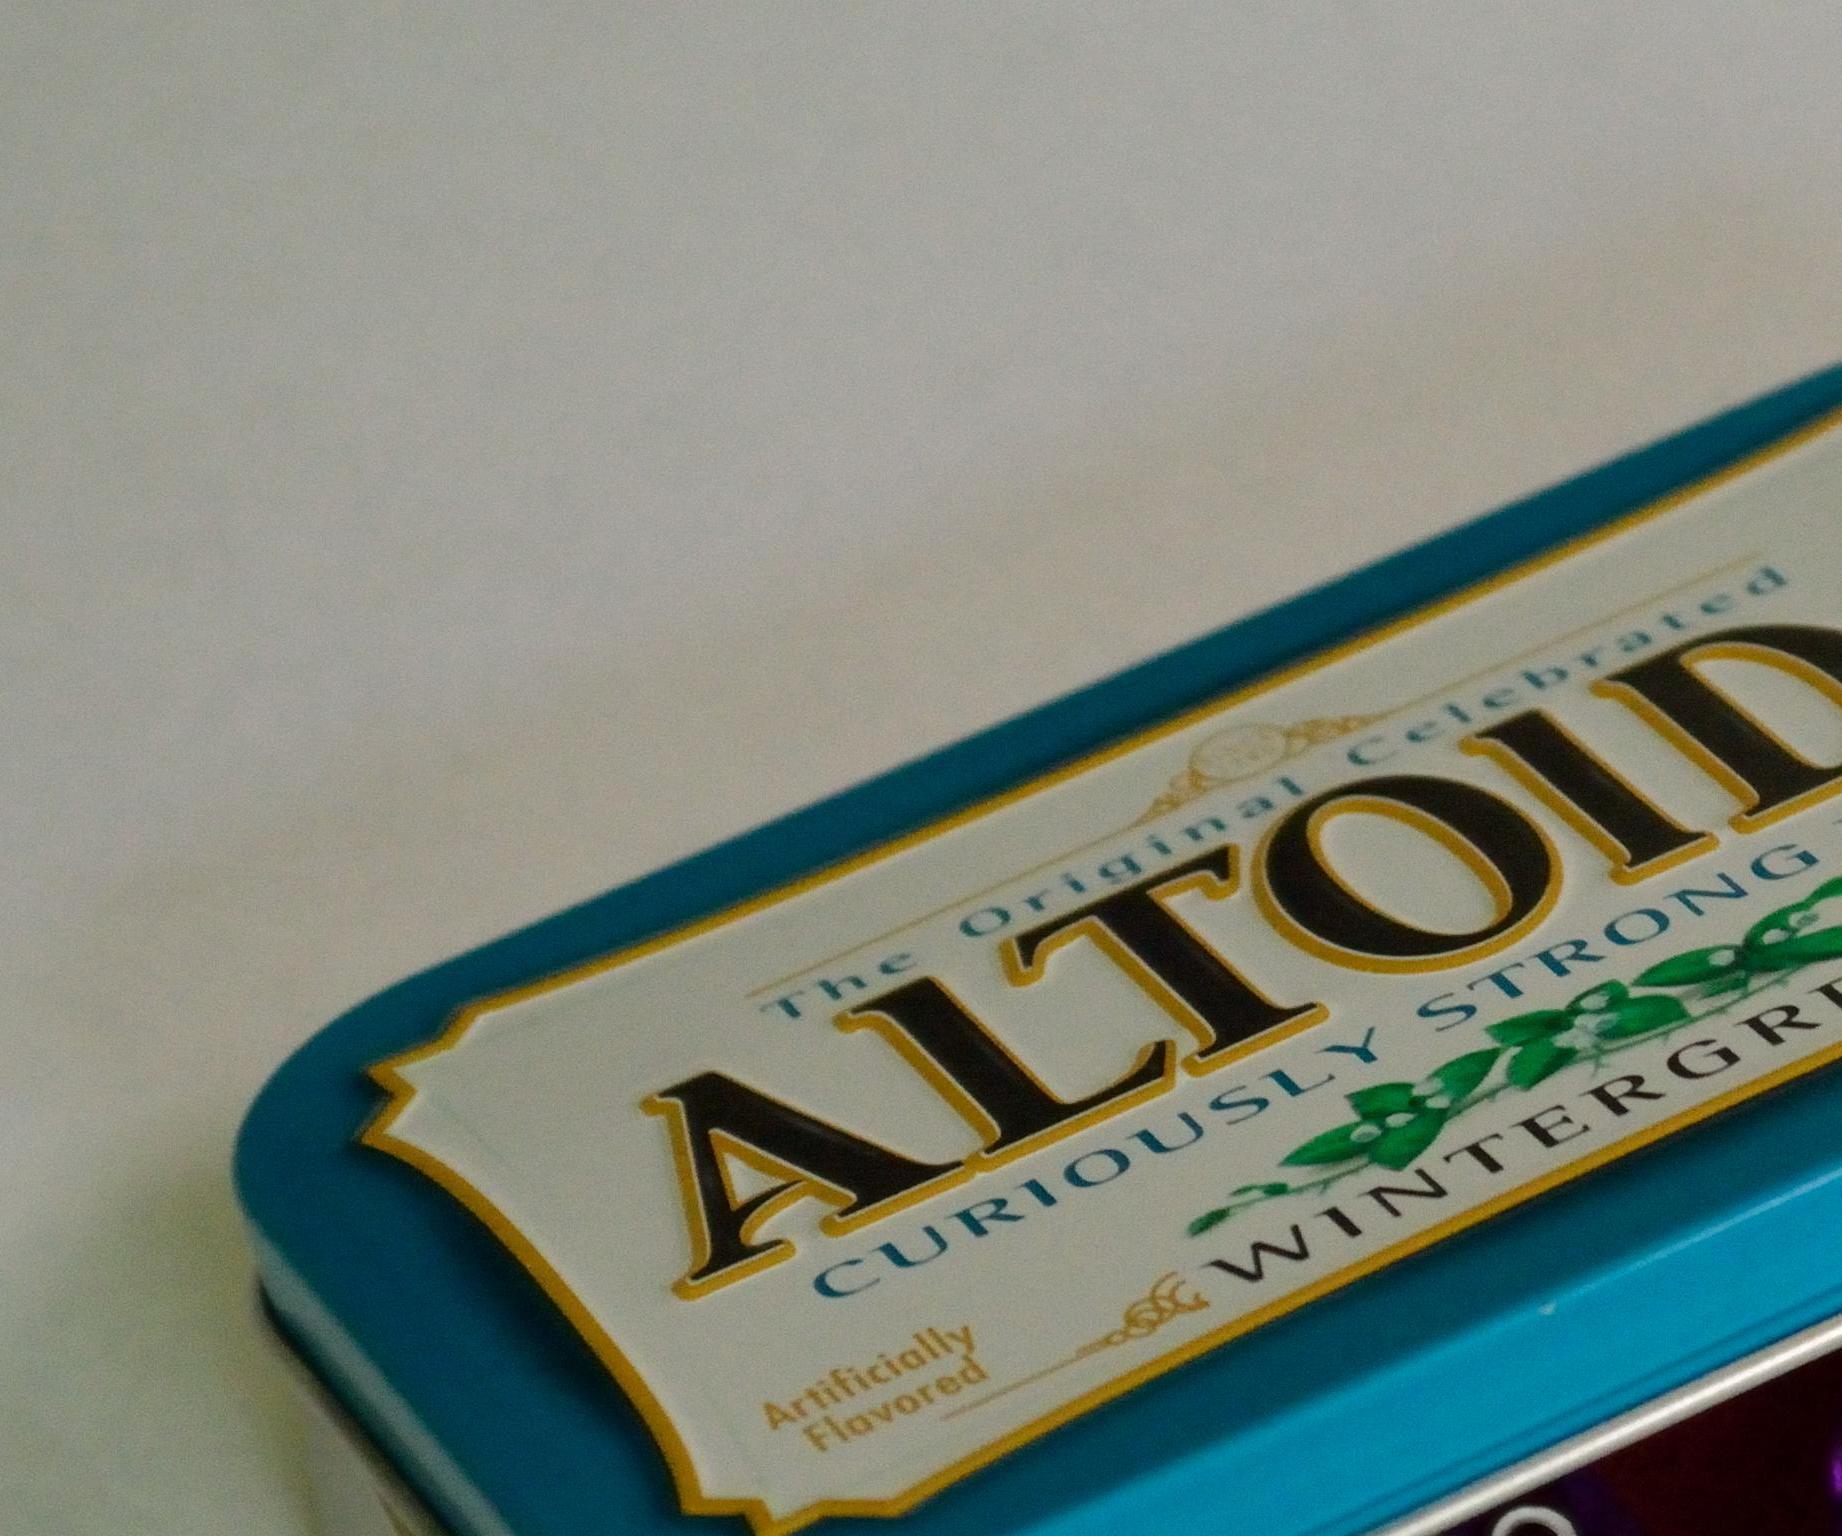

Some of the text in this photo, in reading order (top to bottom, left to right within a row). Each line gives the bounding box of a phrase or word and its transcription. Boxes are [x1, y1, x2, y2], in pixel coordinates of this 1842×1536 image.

[760, 565, 1790, 1021] The Original Celebrated
[812, 1027, 1377, 1298] CURIOUSLY
[1416, 842, 1821, 1033] STRONG
[763, 1325, 976, 1430] Artificially
[803, 1354, 989, 1451] Flavored
